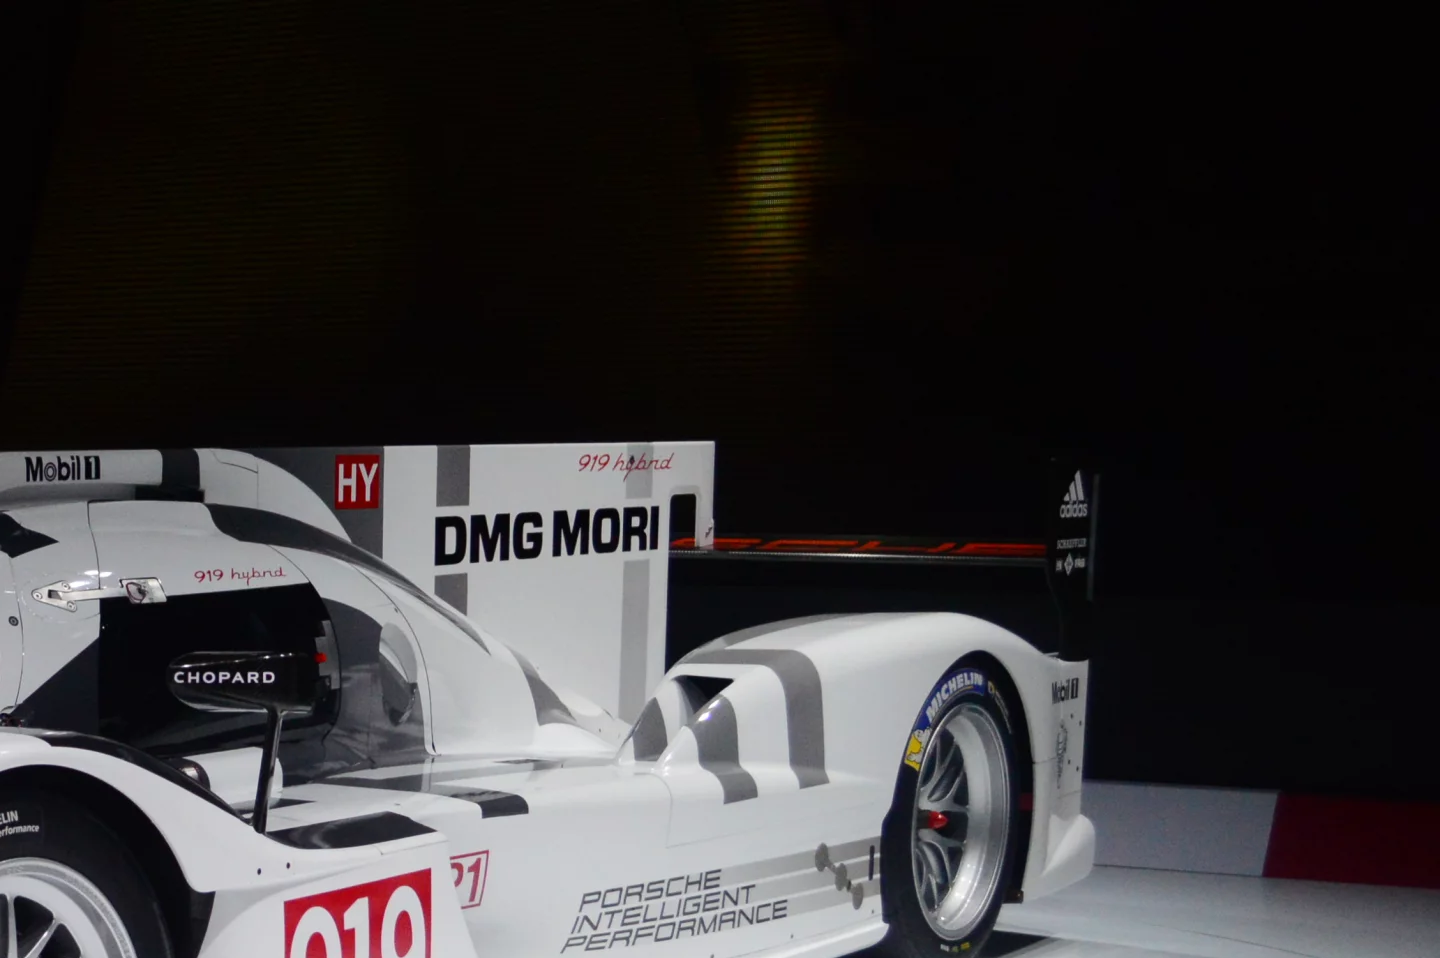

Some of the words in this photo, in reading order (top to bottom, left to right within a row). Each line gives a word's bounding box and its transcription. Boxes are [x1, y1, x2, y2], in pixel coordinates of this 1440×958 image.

[24, 455, 81, 482] Mobil
[337, 463, 379, 503] HY
[578, 453, 611, 472] 919
[612, 452, 675, 482] hybrid
[1059, 500, 1088, 518] adidas
[433, 510, 544, 566] DMG
[552, 505, 660, 557] MORI
[193, 569, 224, 583] 919
[231, 566, 287, 586] hybrid
[174, 671, 276, 684] CHOPARD
[1051, 679, 1070, 705] Mobil
[1071, 677, 1079, 699] 1
[925, 671, 985, 723] MICHELIN
[578, 868, 722, 913] PORSCHE
[560, 899, 789, 954] PERFORMANCE
[570, 884, 757, 934] INTELLIGENT
